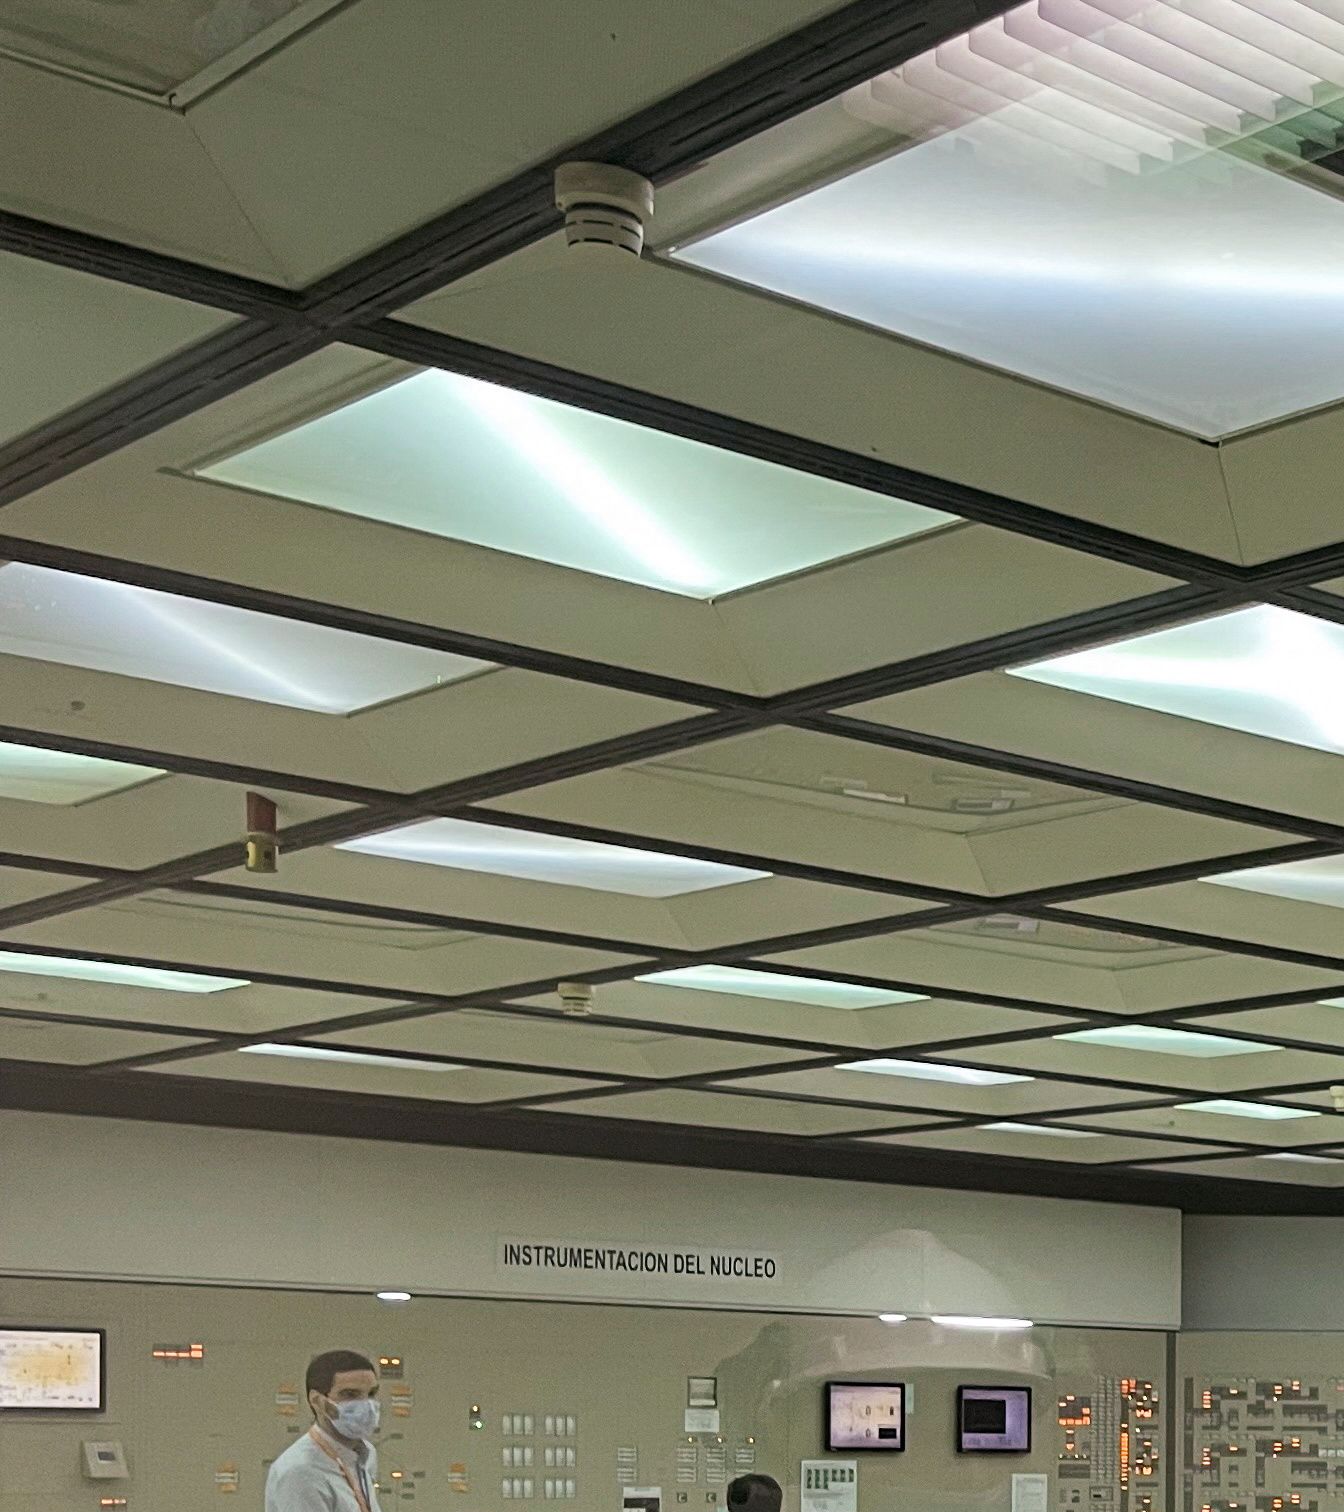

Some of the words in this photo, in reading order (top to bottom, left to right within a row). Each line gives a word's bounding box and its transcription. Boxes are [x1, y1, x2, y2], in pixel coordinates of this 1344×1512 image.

[504, 1243, 668, 1273] INSTRUMENTACION
[673, 1254, 705, 1275] DEL
[710, 1255, 776, 1279] NUCLEO
